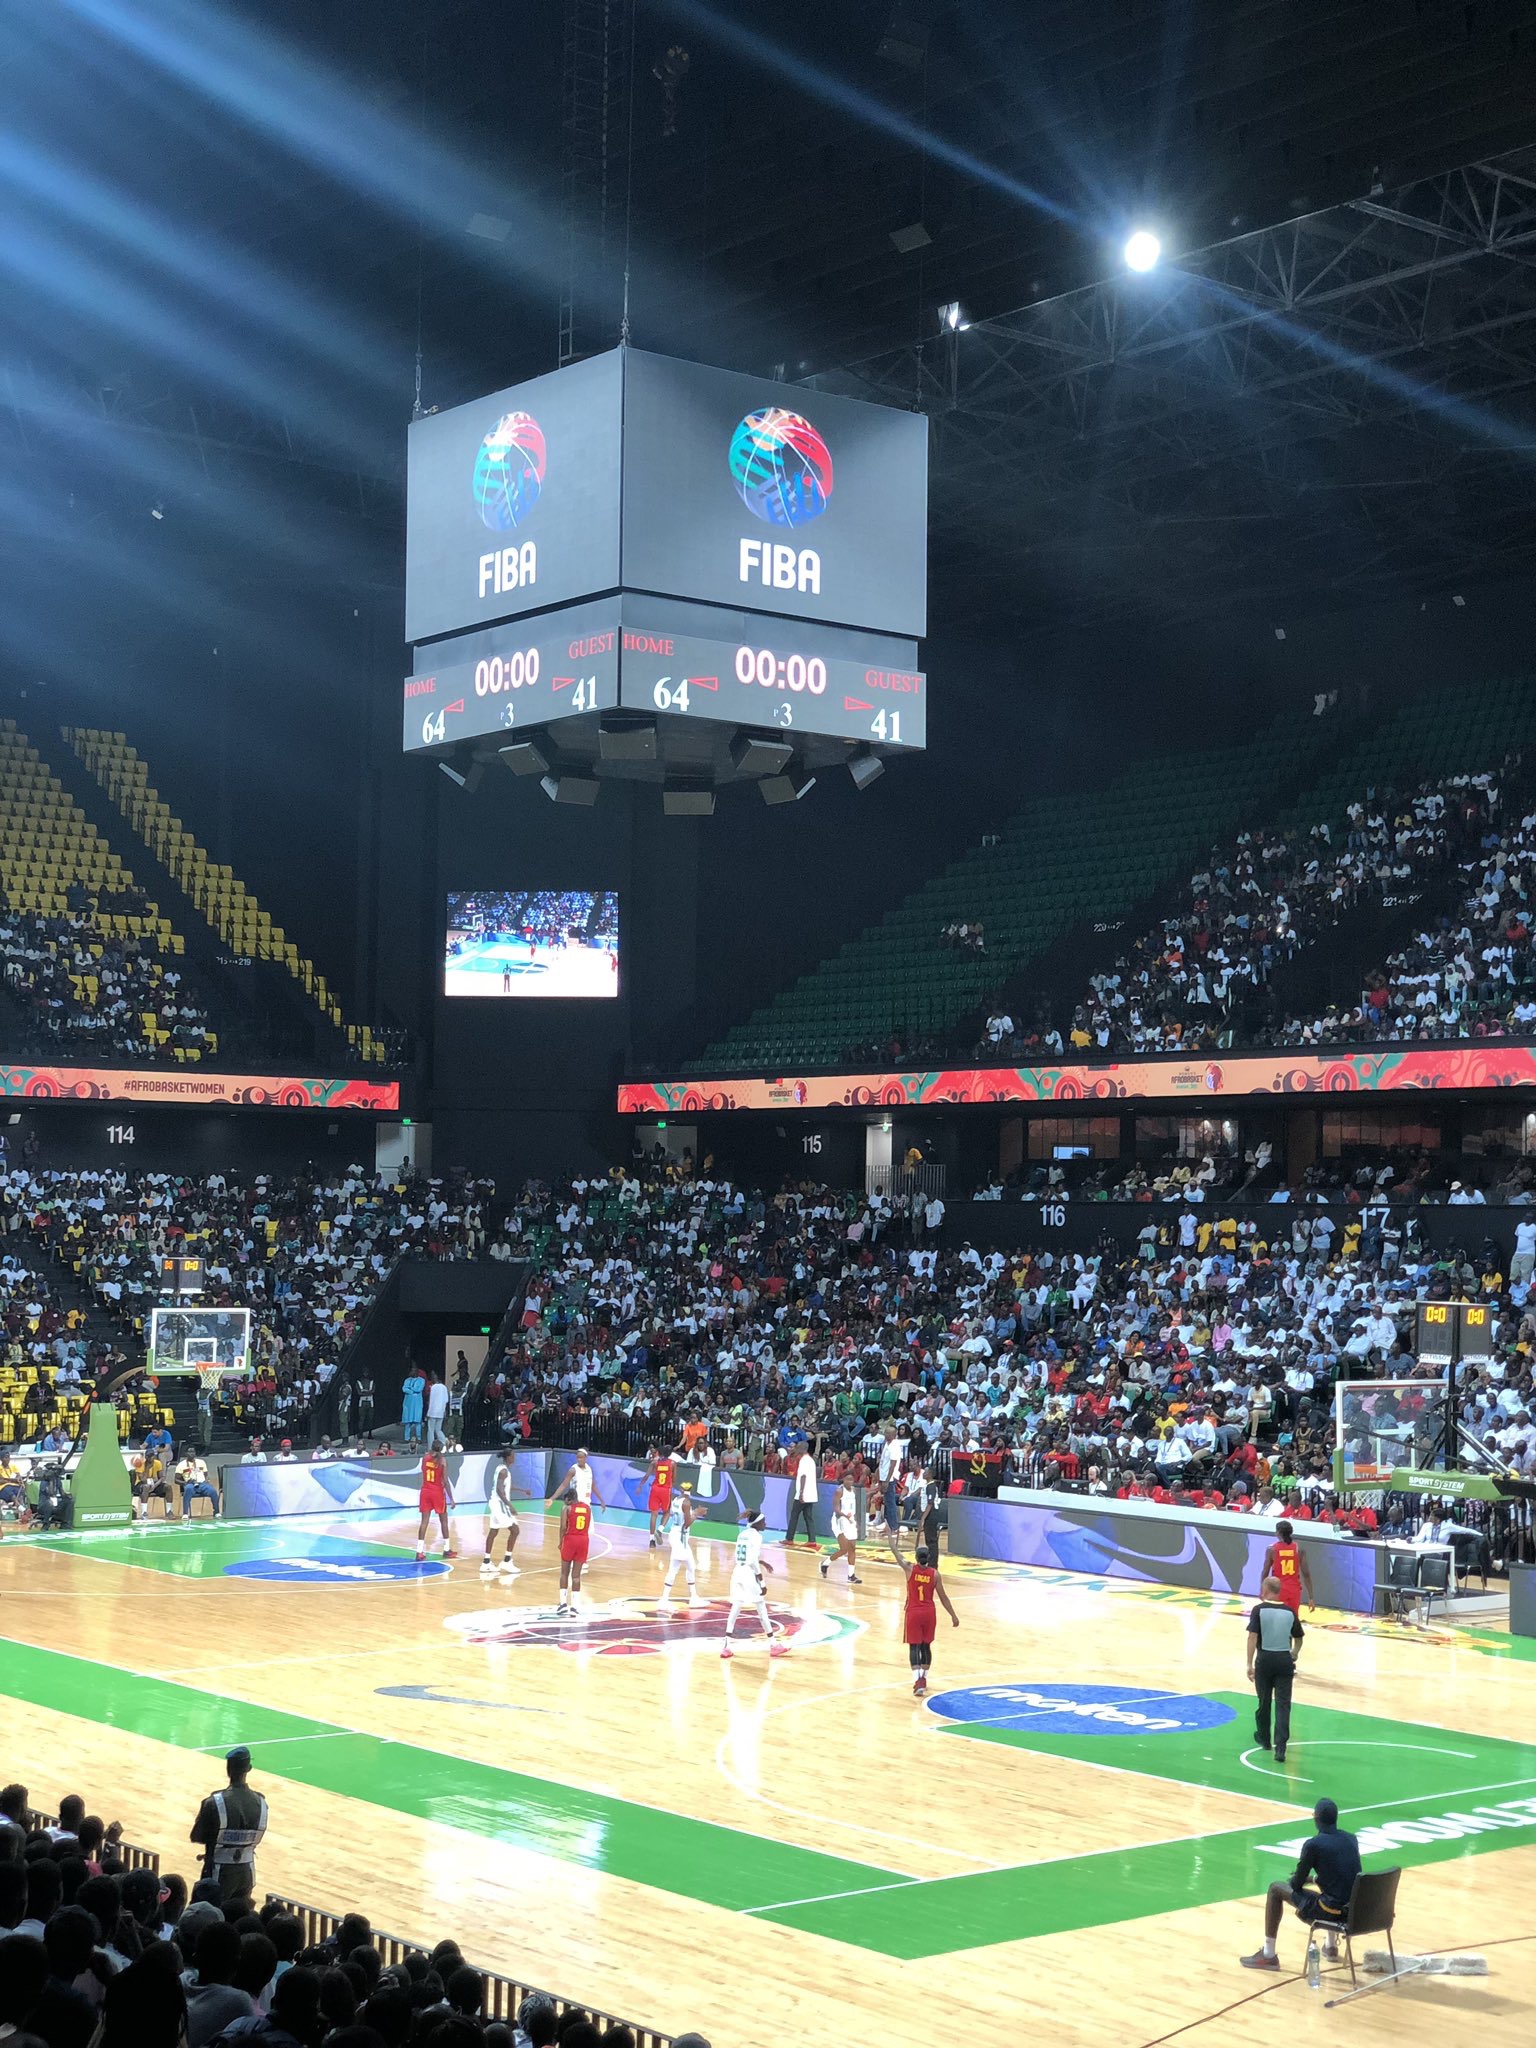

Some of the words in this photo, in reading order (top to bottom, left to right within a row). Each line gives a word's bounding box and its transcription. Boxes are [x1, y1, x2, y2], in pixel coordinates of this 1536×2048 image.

[478, 540, 537, 598] FIBA
[739, 538, 821, 595] FIBA
[568, 632, 615, 659] GUEST
[623, 634, 674, 657] HOME
[475, 647, 540, 697] 00:00
[735, 646, 827, 695] 00:00
[865, 670, 922, 694] GUEST
[405, 677, 436, 698] HOME
[572, 675, 598, 711] 41
[653, 677, 690, 712] 64
[505, 702, 515, 727] 3
[780, 702, 792, 727] 3
[870, 708, 902, 742] 41
[422, 709, 446, 744] 64
[124, 1080, 225, 1094] #AFROBASKETWOMEN
[106, 1125, 135, 1144] 114
[801, 1135, 822, 1153] 115
[1040, 1205, 1066, 1226] 116
[1426, 1306, 1446, 1323] 0:0
[1467, 1308, 1485, 1325] 0:0
[426, 1469, 435, 1482] 11
[658, 1473, 667, 1485] 8
[1409, 1476, 1434, 1486] SPORT
[575, 1515, 586, 1530] 6
[1280, 1559, 1295, 1576] 14
[917, 1585, 924, 1601] 1
[958, 1565, 1245, 1608] DAKAR
